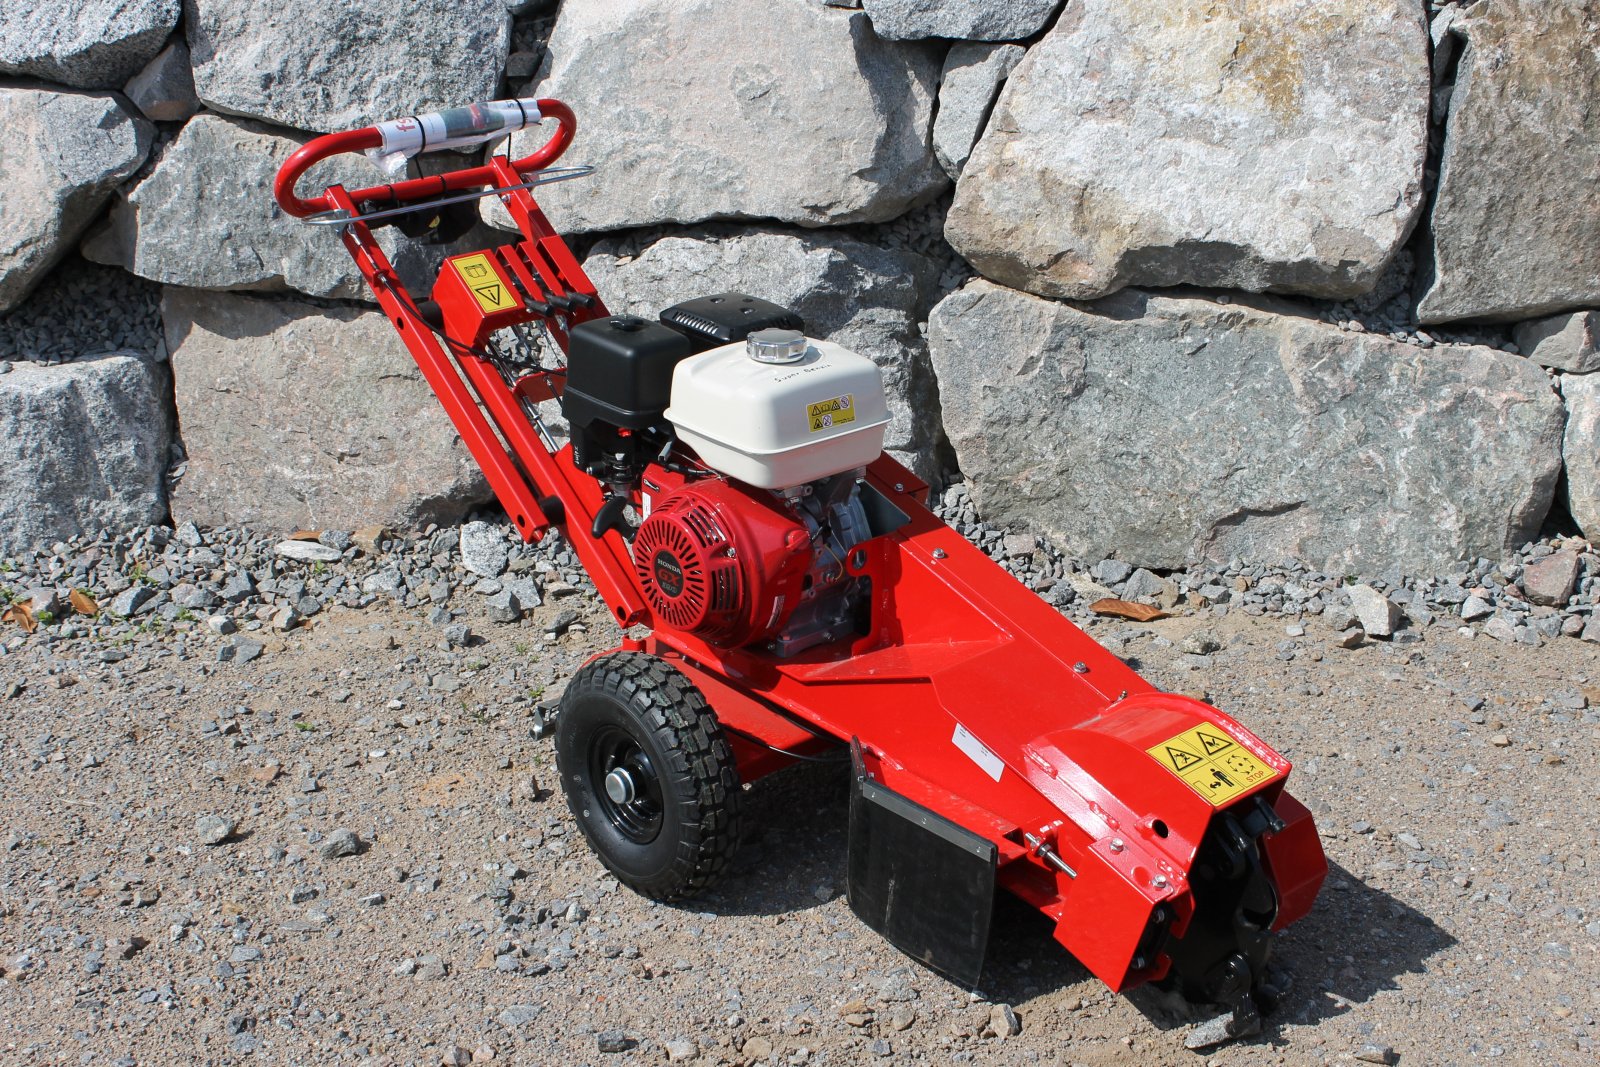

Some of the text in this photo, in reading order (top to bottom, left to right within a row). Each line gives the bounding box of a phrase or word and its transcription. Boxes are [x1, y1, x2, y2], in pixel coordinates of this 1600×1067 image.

[657, 558, 682, 575] HONDA
[658, 568, 681, 586] GX
[1245, 770, 1264, 783] STOP
